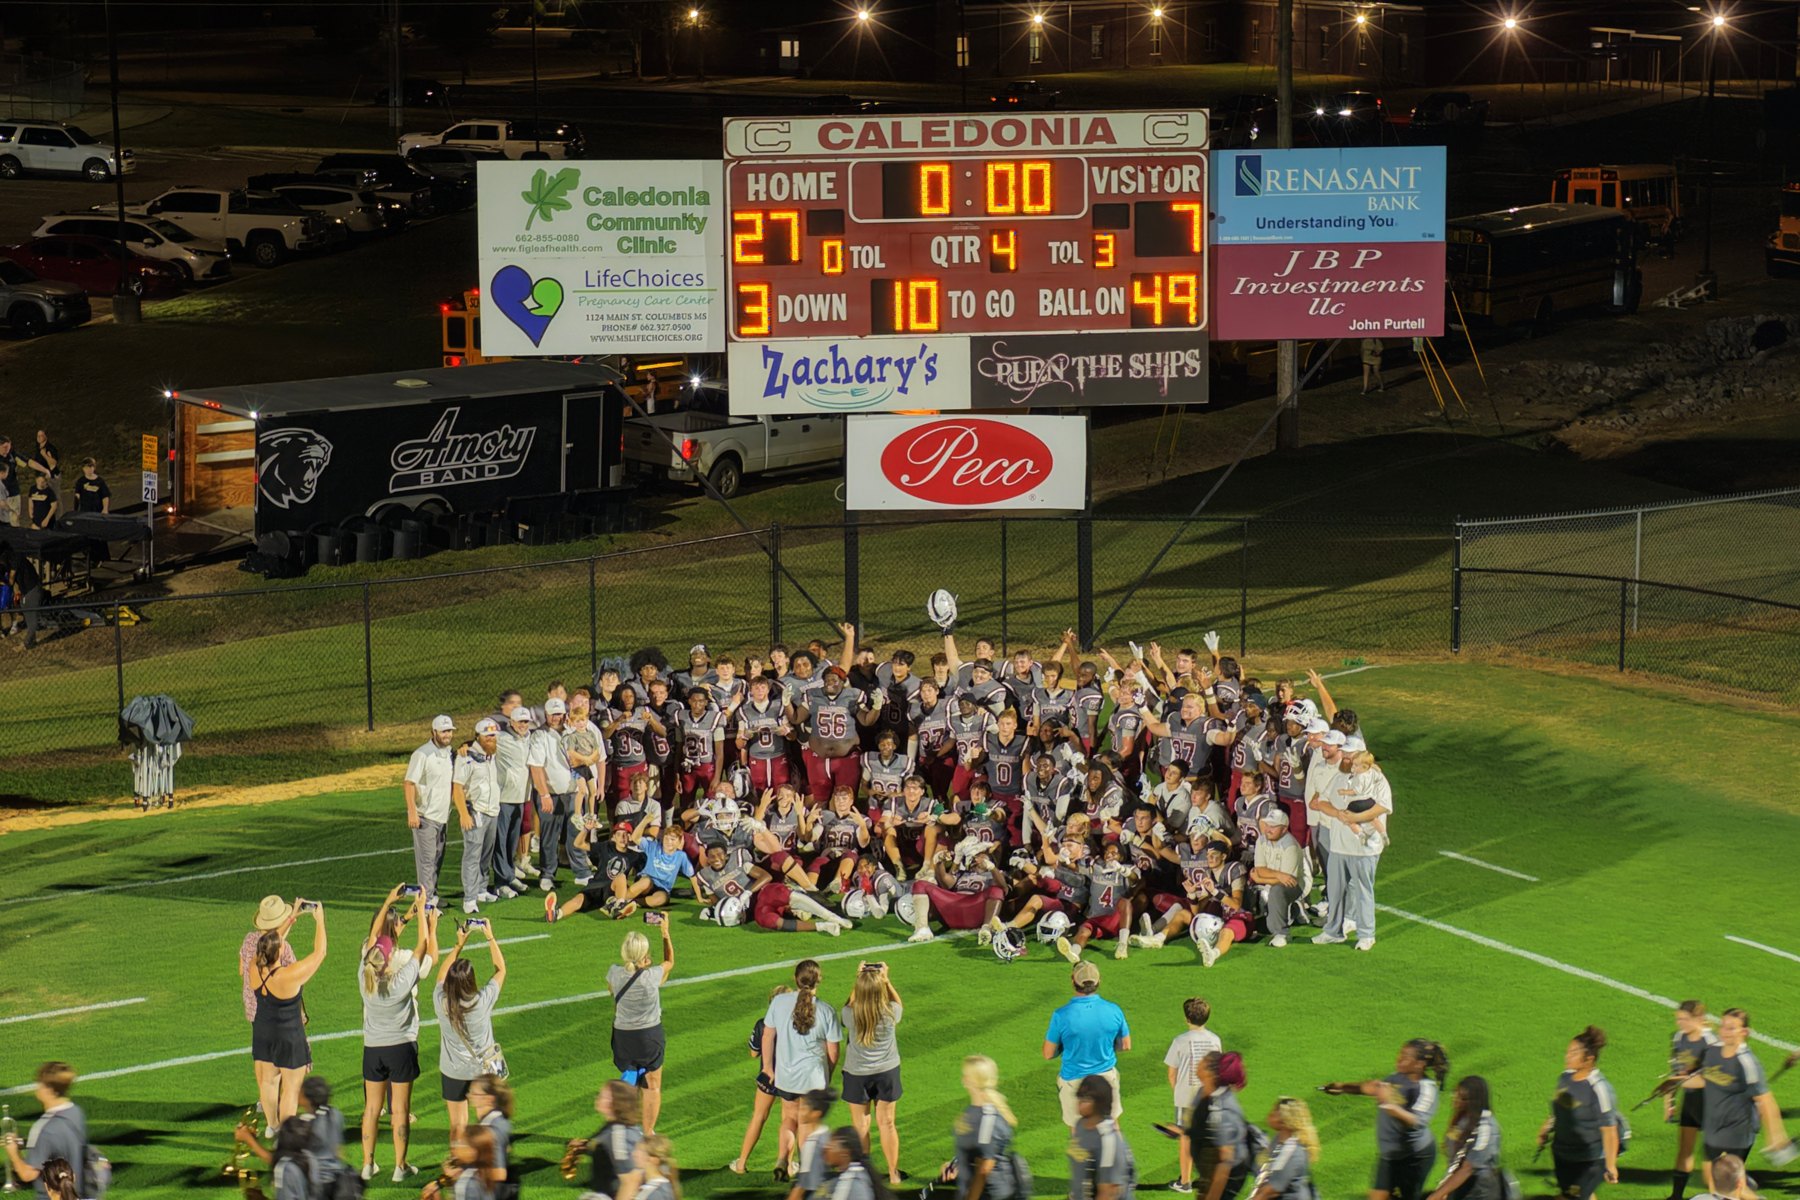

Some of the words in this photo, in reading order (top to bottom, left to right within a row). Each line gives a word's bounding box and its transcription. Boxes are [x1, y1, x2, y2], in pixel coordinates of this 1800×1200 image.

[745, 121, 791, 153] C
[817, 117, 1118, 150] CALEDONIA
[1143, 114, 1188, 145] C
[747, 171, 837, 201] HOME
[1091, 164, 1200, 194] VISITOR
[1265, 167, 1422, 191] RENASANT
[583, 186, 710, 206] Caledonia
[1368, 196, 1420, 211] BANK
[587, 213, 708, 234] Community
[1171, 203, 1201, 253] 7
[1256, 216, 1365, 230] Understanding
[515, 234, 580, 242] 662-855-0080
[617, 236, 677, 253] Clinic
[734, 211, 800, 262] 27
[492, 244, 603, 254] www.figleafhealth.com
[823, 240, 843, 273] 0
[850, 246, 885, 268] TOL
[931, 236, 980, 268] QTR
[992, 230, 1016, 270] 4
[1048, 241, 1084, 264] TOL
[1094, 234, 1115, 267] 3
[1273, 250, 1304, 277] J
[1309, 249, 1340, 270] B
[1349, 249, 1382, 269] P
[585, 269, 704, 288] LifeChoices
[1230, 276, 1426, 295] Investments
[578, 296, 640, 308] Pregnancy
[644, 296, 672, 306] Care
[676, 295, 714, 305] Center
[739, 284, 769, 334] 3
[778, 293, 847, 323] DOWN
[895, 281, 938, 331] 10
[948, 290, 976, 318] TO
[985, 290, 1015, 318] GO
[1039, 288, 1092, 317] BALL
[1095, 287, 1125, 315] ON
[1133, 274, 1198, 325] 49
[1308, 297, 1346, 315] llc
[601, 324, 637, 332] PHONE#
[640, 323, 691, 331] 662.327.0500
[607, 313, 629, 321] MAIN
[645, 313, 692, 321] COLUMBUS
[1349, 319, 1381, 331] John
[1384, 318, 1425, 330] Purtell
[590, 334, 703, 342] WWW.MSLIFECHOICES.ORG
[762, 343, 938, 399] Zachary's
[1072, 355, 1122, 390] THE
[1129, 349, 1201, 396] SHIPS
[391, 406, 537, 470] Amory
[900, 425, 1040, 487] Peco
[420, 465, 500, 485] BAND
[144, 487, 156, 502] 20
[817, 711, 847, 738] 56
[996, 762, 1012, 786] 0
[1099, 886, 1114, 908] 4
